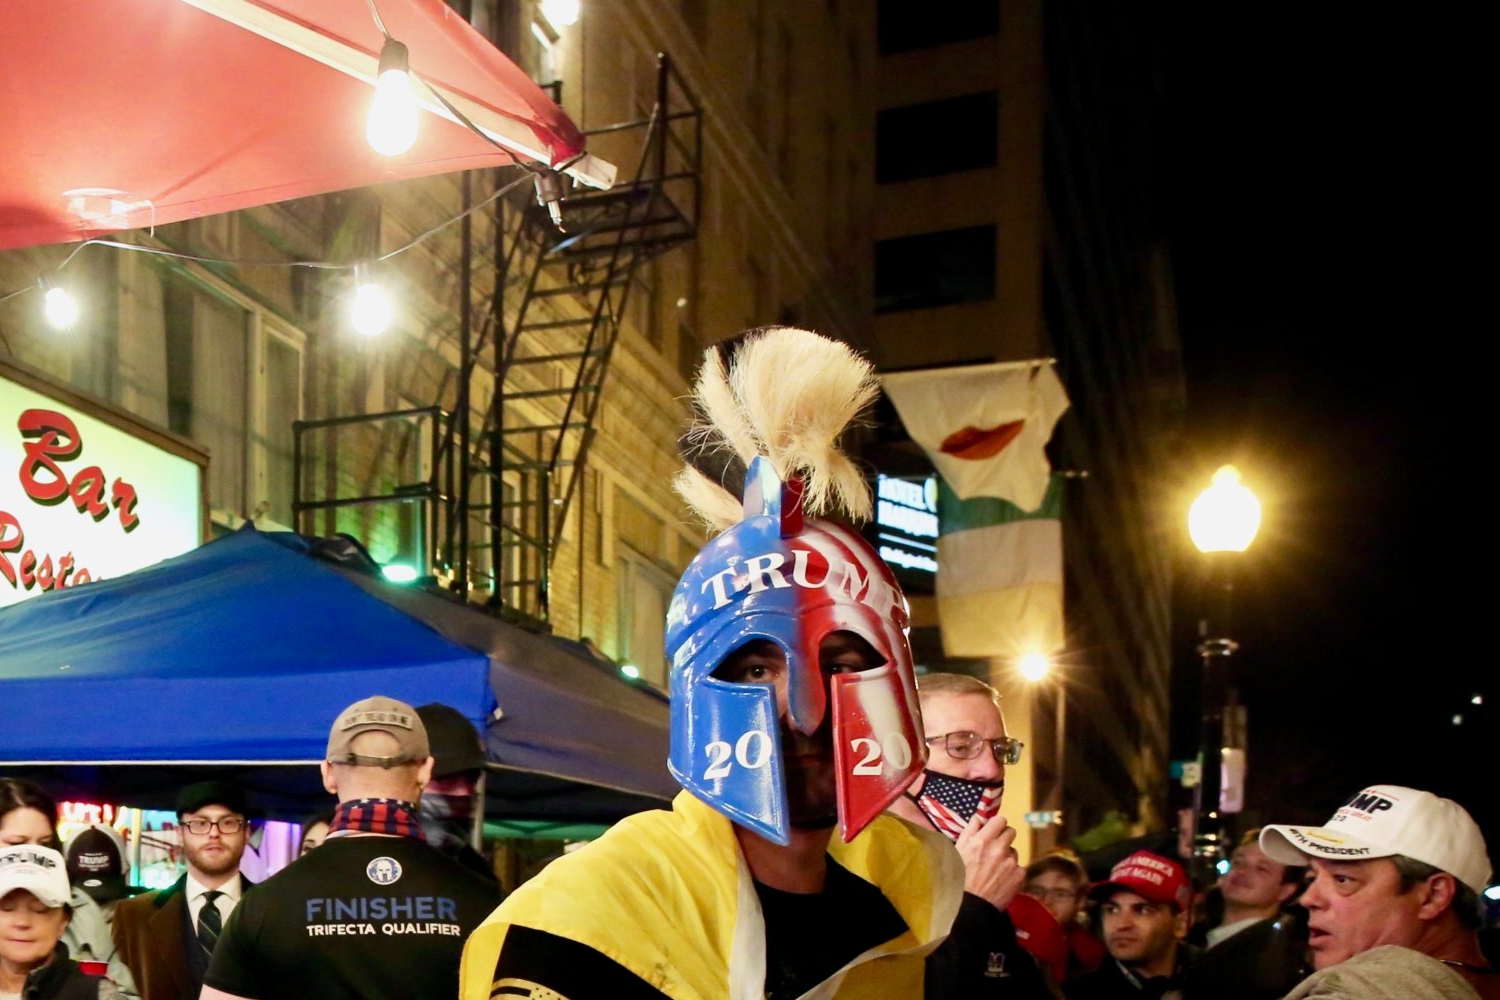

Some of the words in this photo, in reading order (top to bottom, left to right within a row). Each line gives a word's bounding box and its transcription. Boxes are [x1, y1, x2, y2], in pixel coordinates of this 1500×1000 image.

[17, 408, 139, 534] Bar
[701, 549, 906, 612] TRUMP
[703, 729, 772, 780] 20
[850, 731, 912, 776] 20
[1346, 793, 1393, 814] MP
[306, 897, 458, 922] FINISHER
[306, 924, 377, 937] TRIFECTA
[382, 923, 461, 937] QUALIFIER
